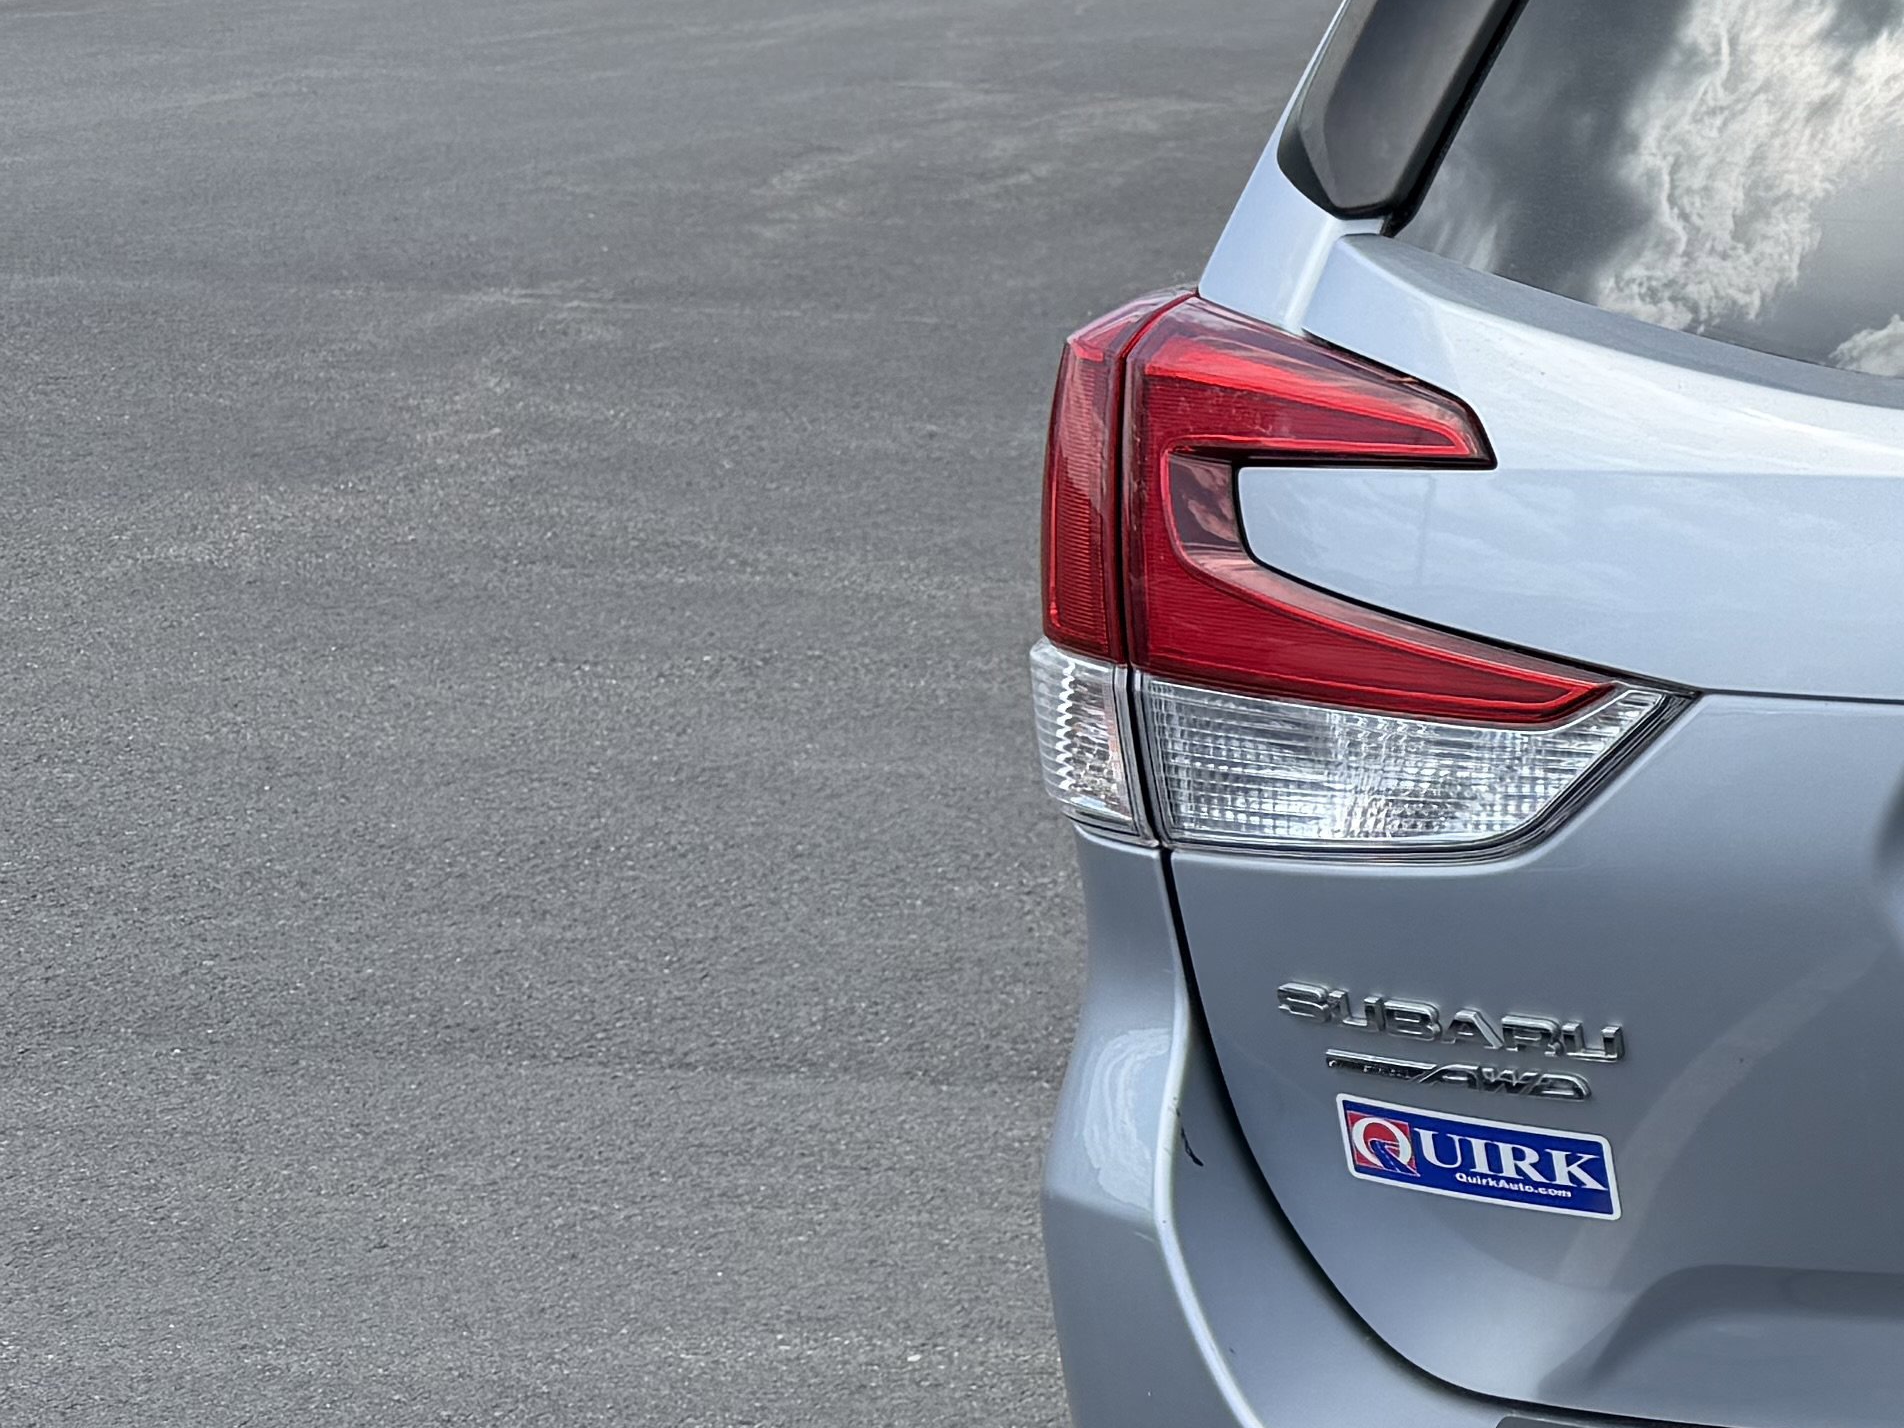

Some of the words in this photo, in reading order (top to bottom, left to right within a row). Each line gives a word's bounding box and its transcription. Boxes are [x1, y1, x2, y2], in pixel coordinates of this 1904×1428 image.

[1277, 981, 1625, 1062] SUBARU
[1416, 1063, 1593, 1101] AWD
[1351, 1116, 1607, 1191] QUIRK
[1455, 1172, 1572, 1198] QuirkAuto.com
